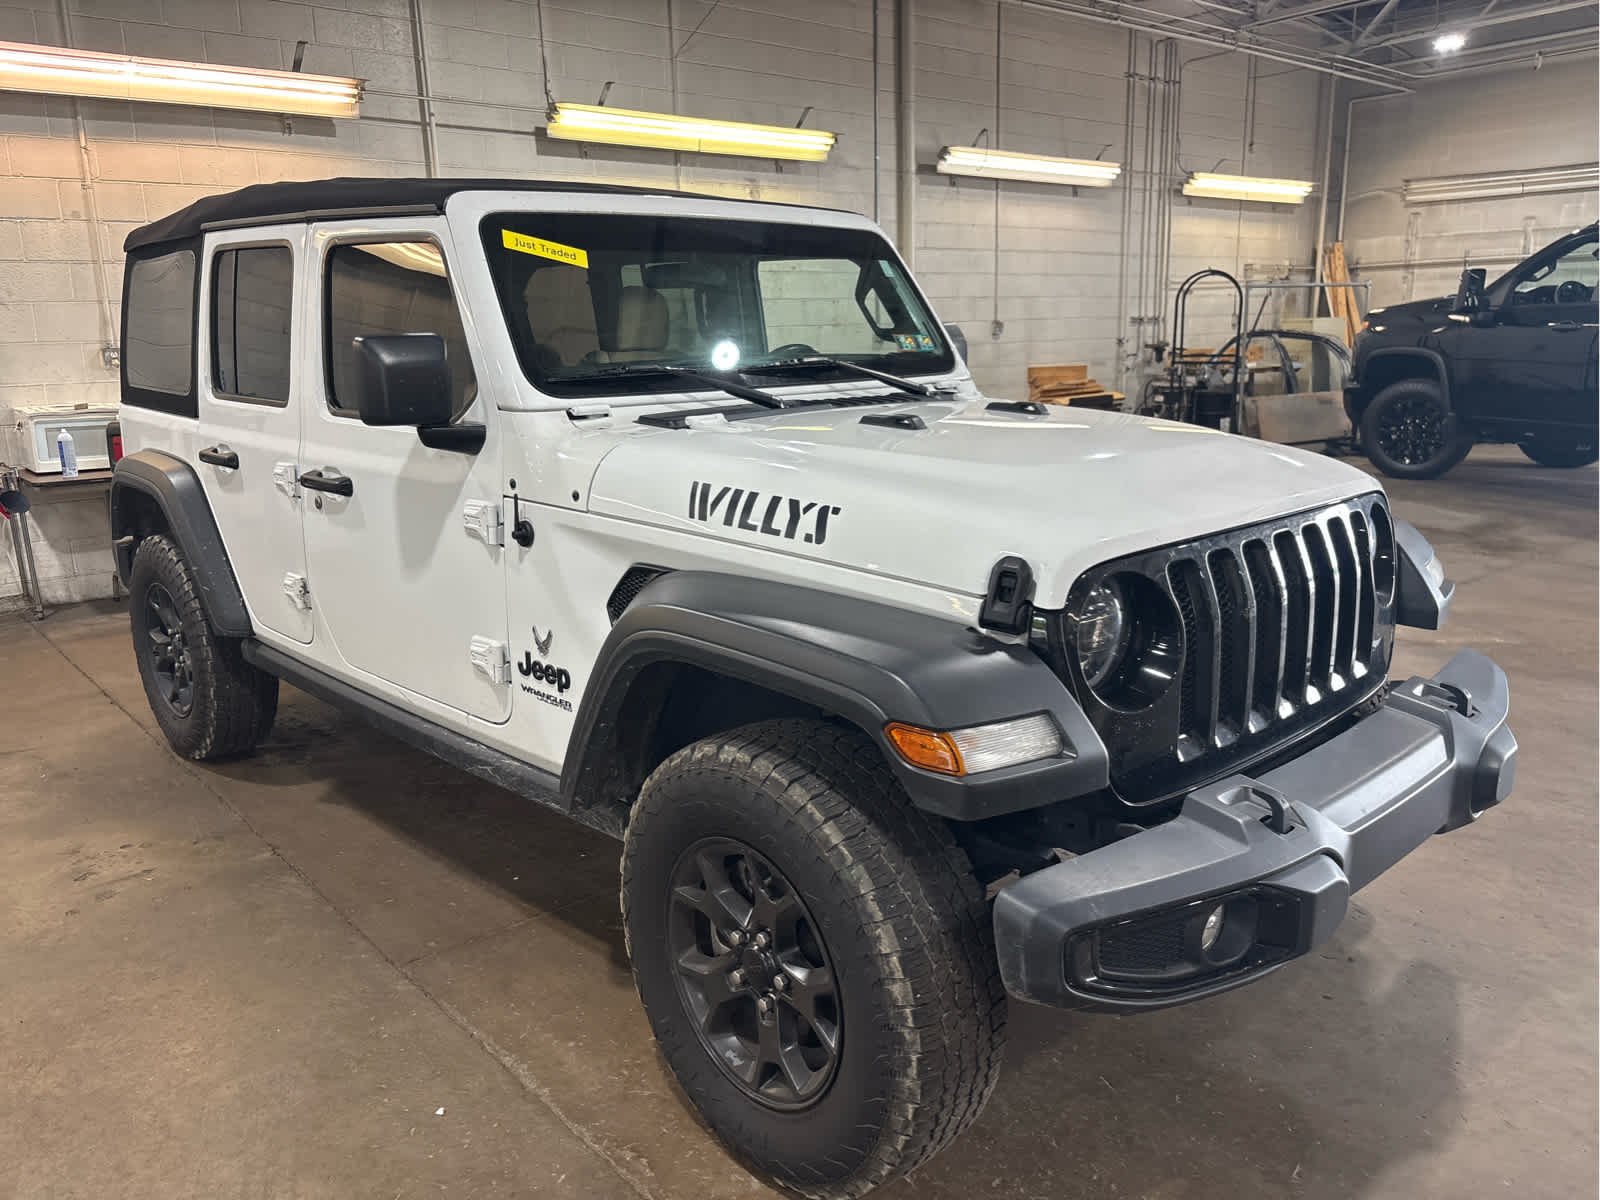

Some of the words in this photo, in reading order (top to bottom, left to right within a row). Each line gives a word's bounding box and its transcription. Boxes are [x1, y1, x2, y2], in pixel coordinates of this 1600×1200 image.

[514, 238, 536, 251] Just
[540, 244, 577, 260] Traded
[688, 480, 842, 545] WILLYS
[517, 650, 571, 693] Jeep
[520, 683, 572, 708] WRANGLER
